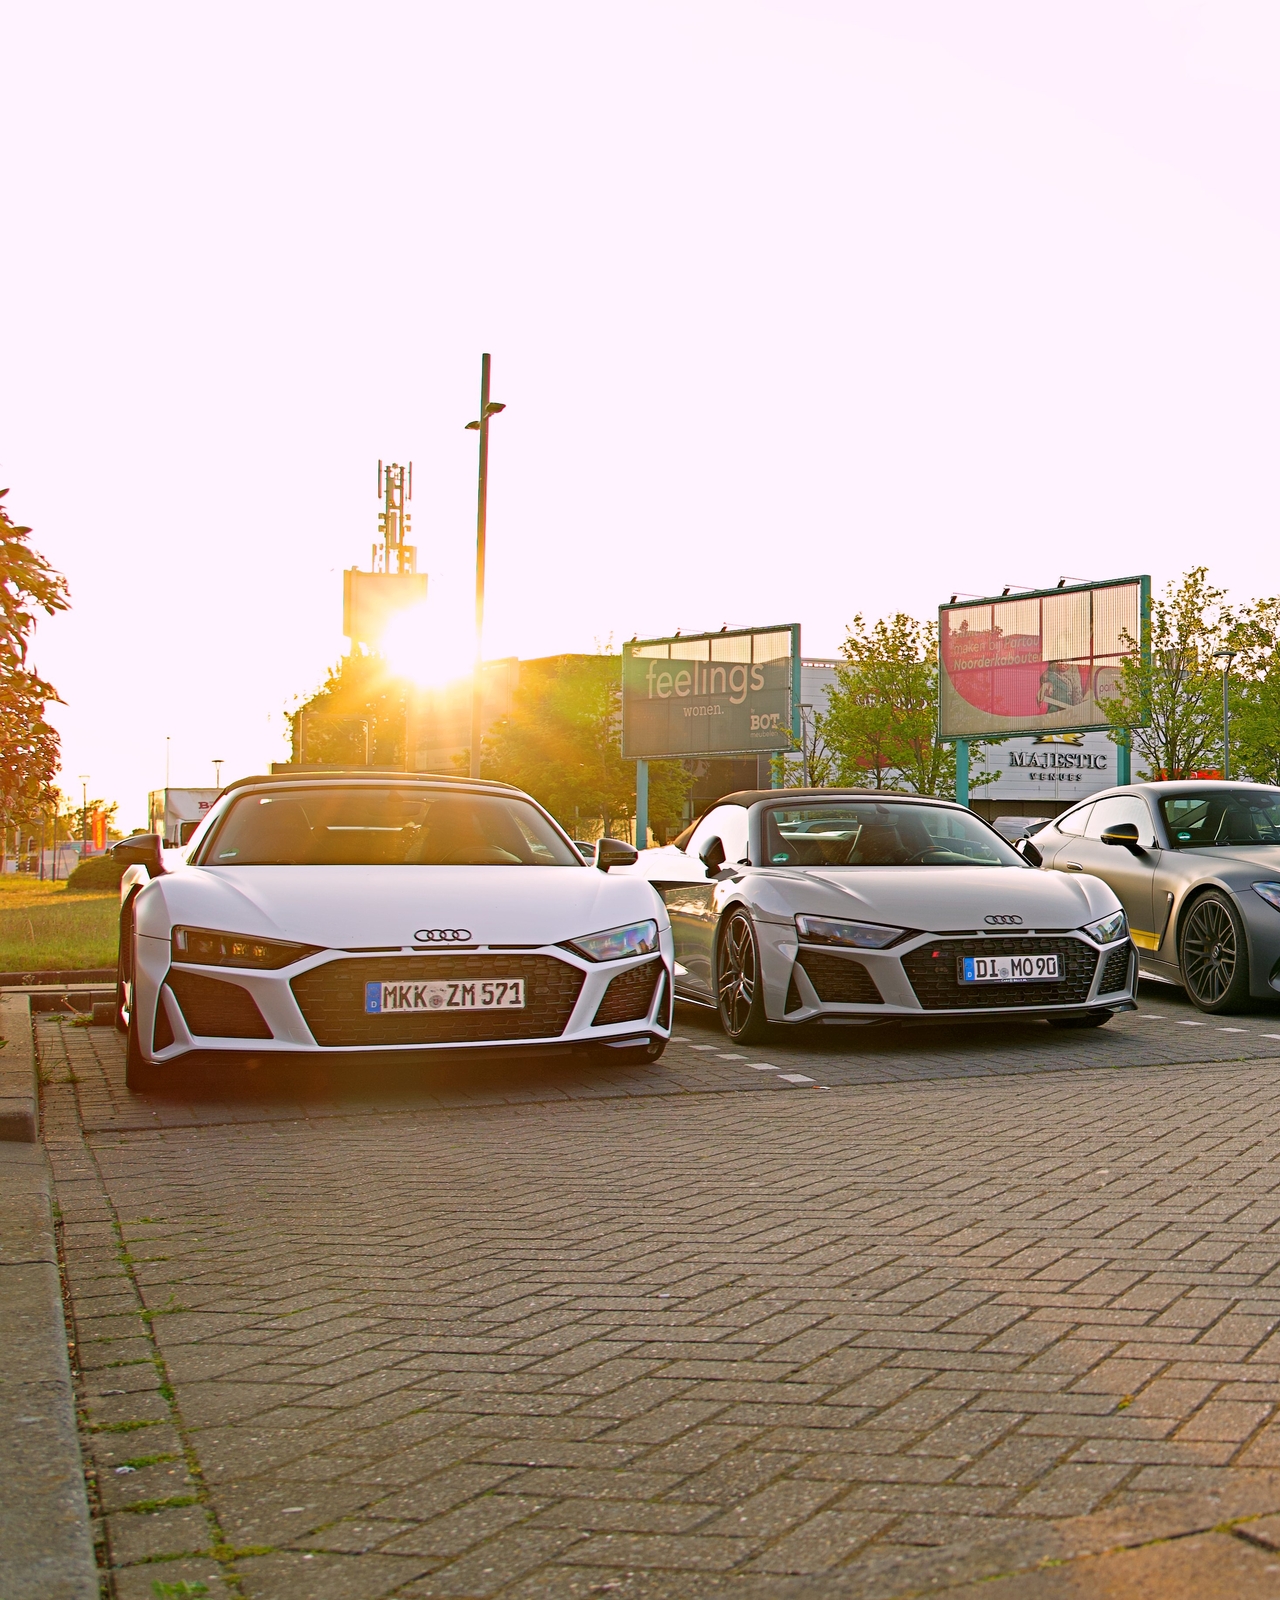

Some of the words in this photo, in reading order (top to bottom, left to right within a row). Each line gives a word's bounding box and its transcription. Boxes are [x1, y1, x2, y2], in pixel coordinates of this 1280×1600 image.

[646, 660, 765, 705] feelings
[683, 704, 725, 718] wonen.
[750, 713, 780, 730] BOT
[1009, 751, 1107, 769] MAJESTIC
[1029, 772, 1082, 781] VENUES
[976, 960, 998, 978] DI
[1011, 958, 1033, 976] MO
[1036, 957, 1057, 976] 90
[384, 985, 428, 1009] MKK
[446, 984, 475, 1006] ZM
[481, 982, 522, 1005] 571
